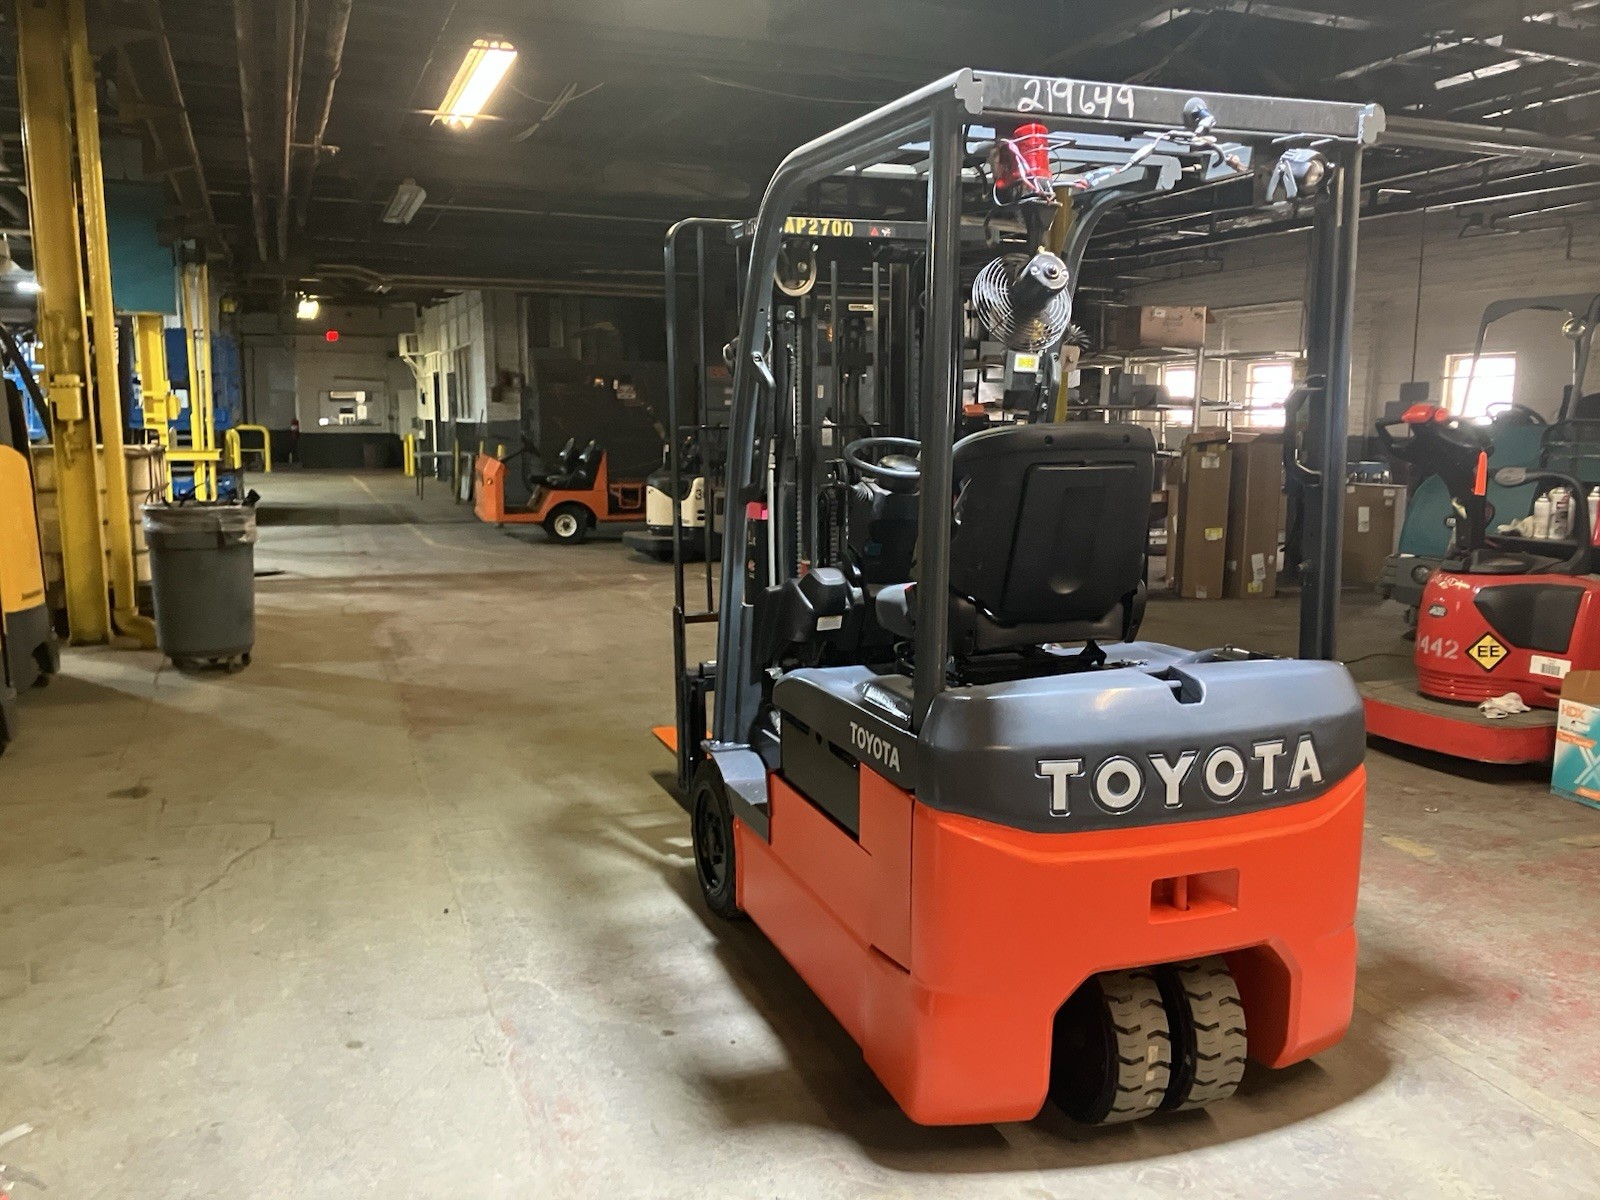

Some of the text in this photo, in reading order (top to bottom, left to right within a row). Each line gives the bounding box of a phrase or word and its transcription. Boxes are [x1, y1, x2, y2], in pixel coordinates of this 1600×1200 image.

[1017, 78, 1135, 119] 219649
[1477, 645, 1501, 658] EE
[849, 720, 901, 773] TOYOTA
[1035, 732, 1325, 817] TOYOTA
